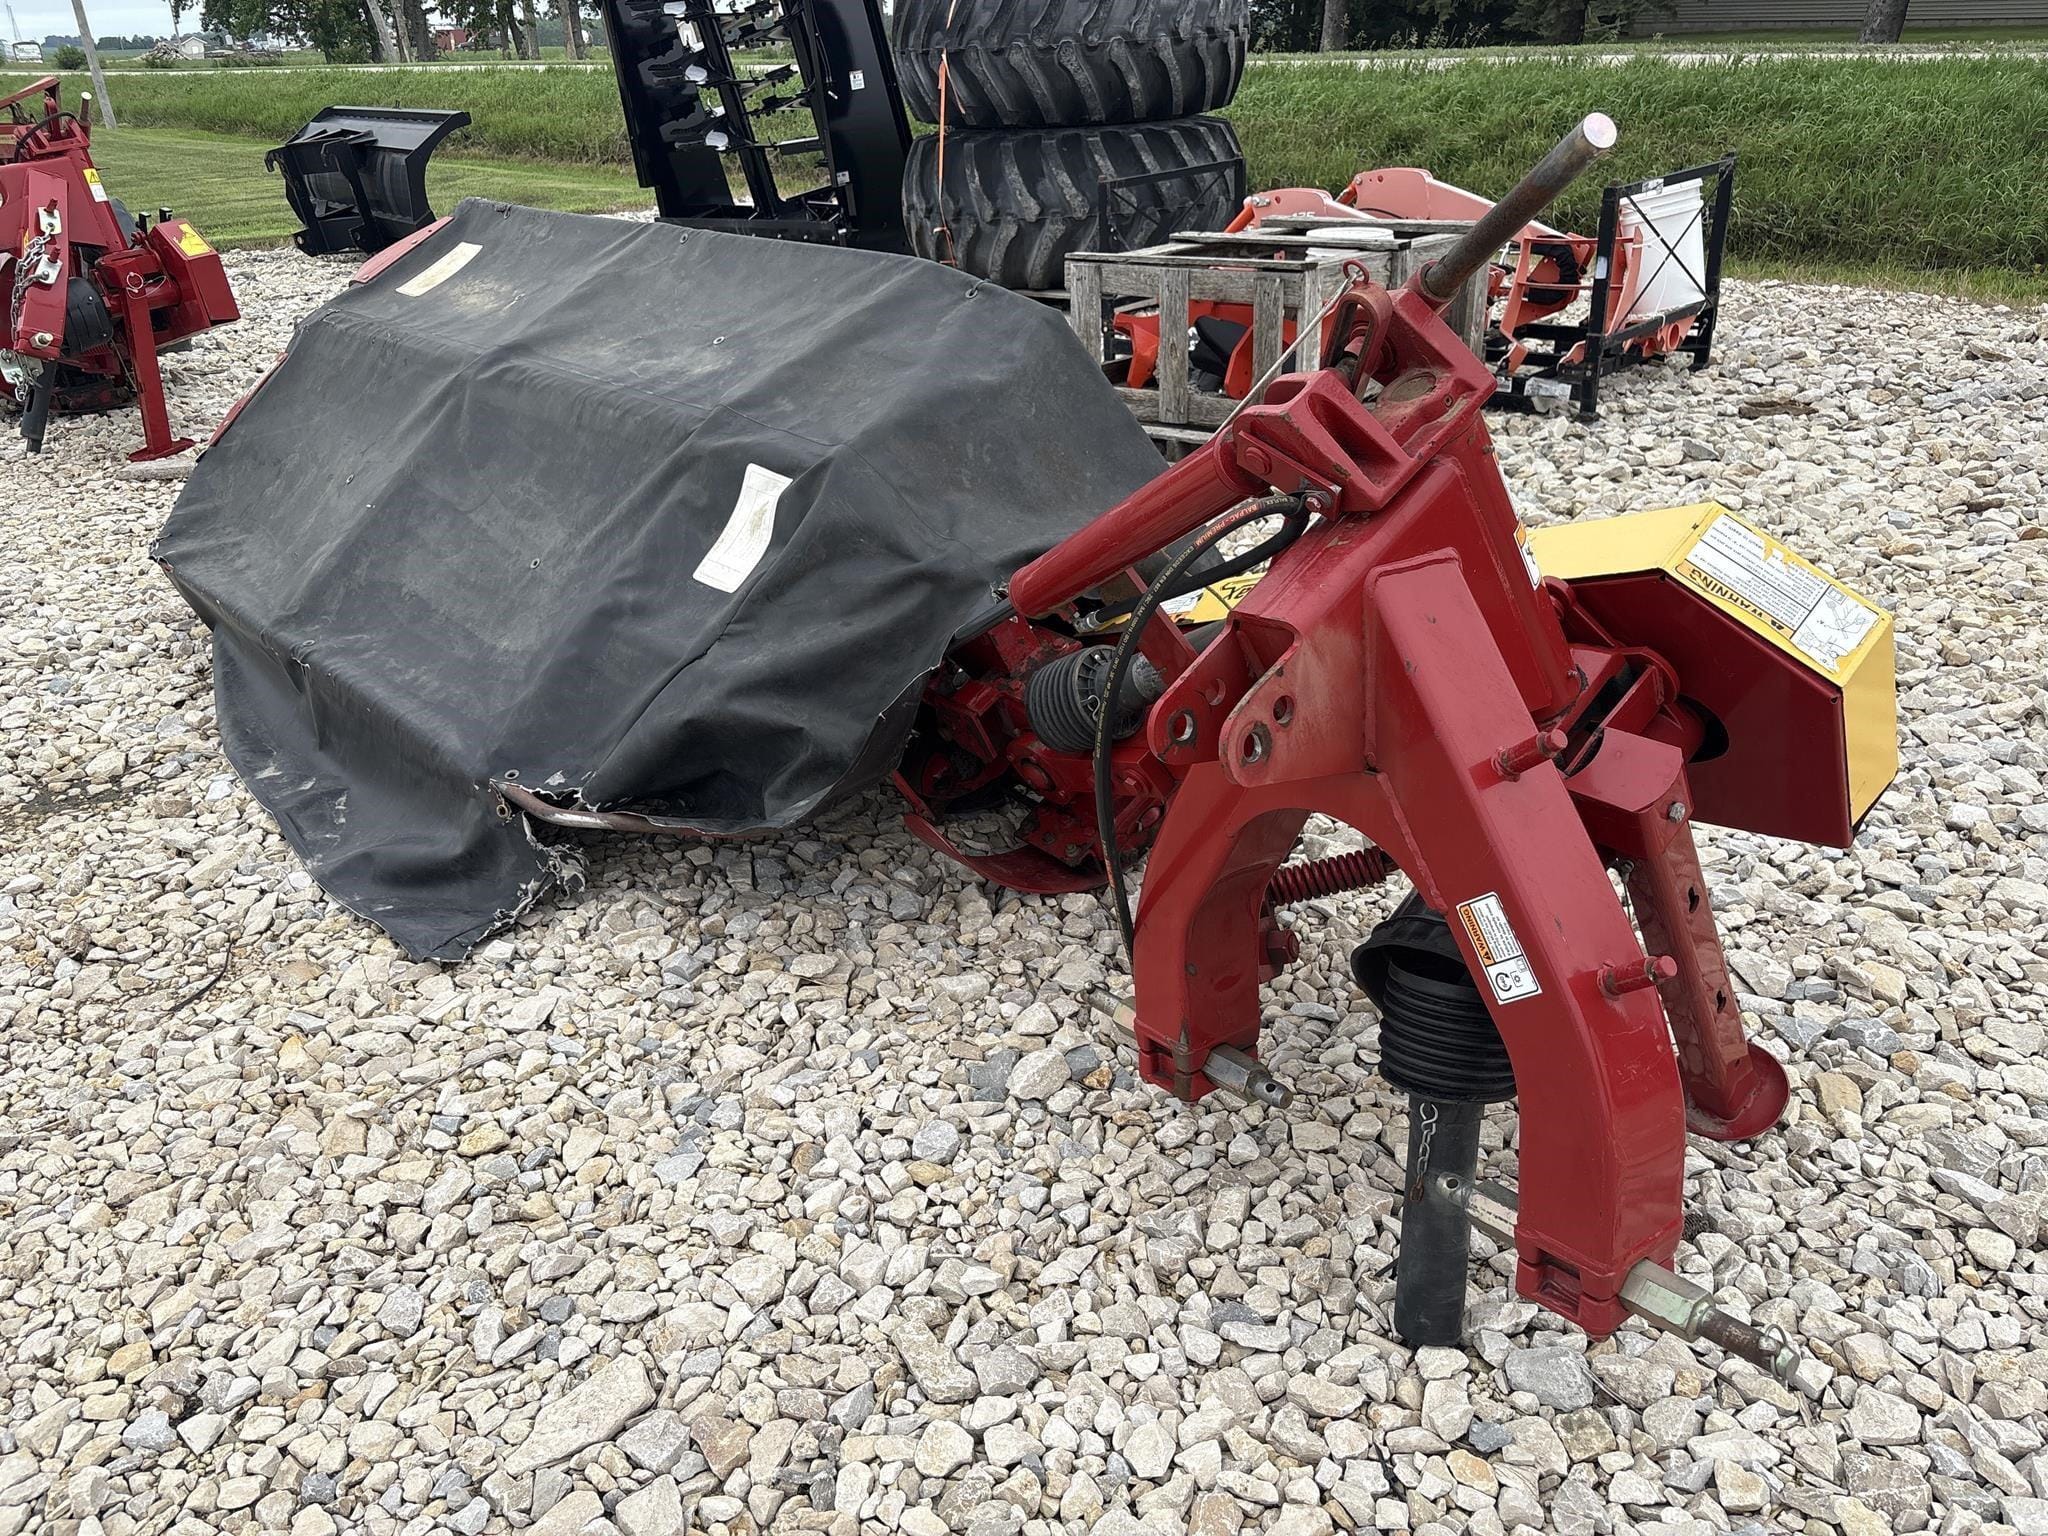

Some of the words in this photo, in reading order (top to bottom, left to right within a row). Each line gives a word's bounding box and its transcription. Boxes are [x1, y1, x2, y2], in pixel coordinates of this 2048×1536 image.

[1230, 503, 1258, 522] BALPAC
[1196, 519, 1226, 546] PREMIUM
[1172, 545, 1194, 569] EXCEEDS
[1463, 909, 1486, 951] WARNING
